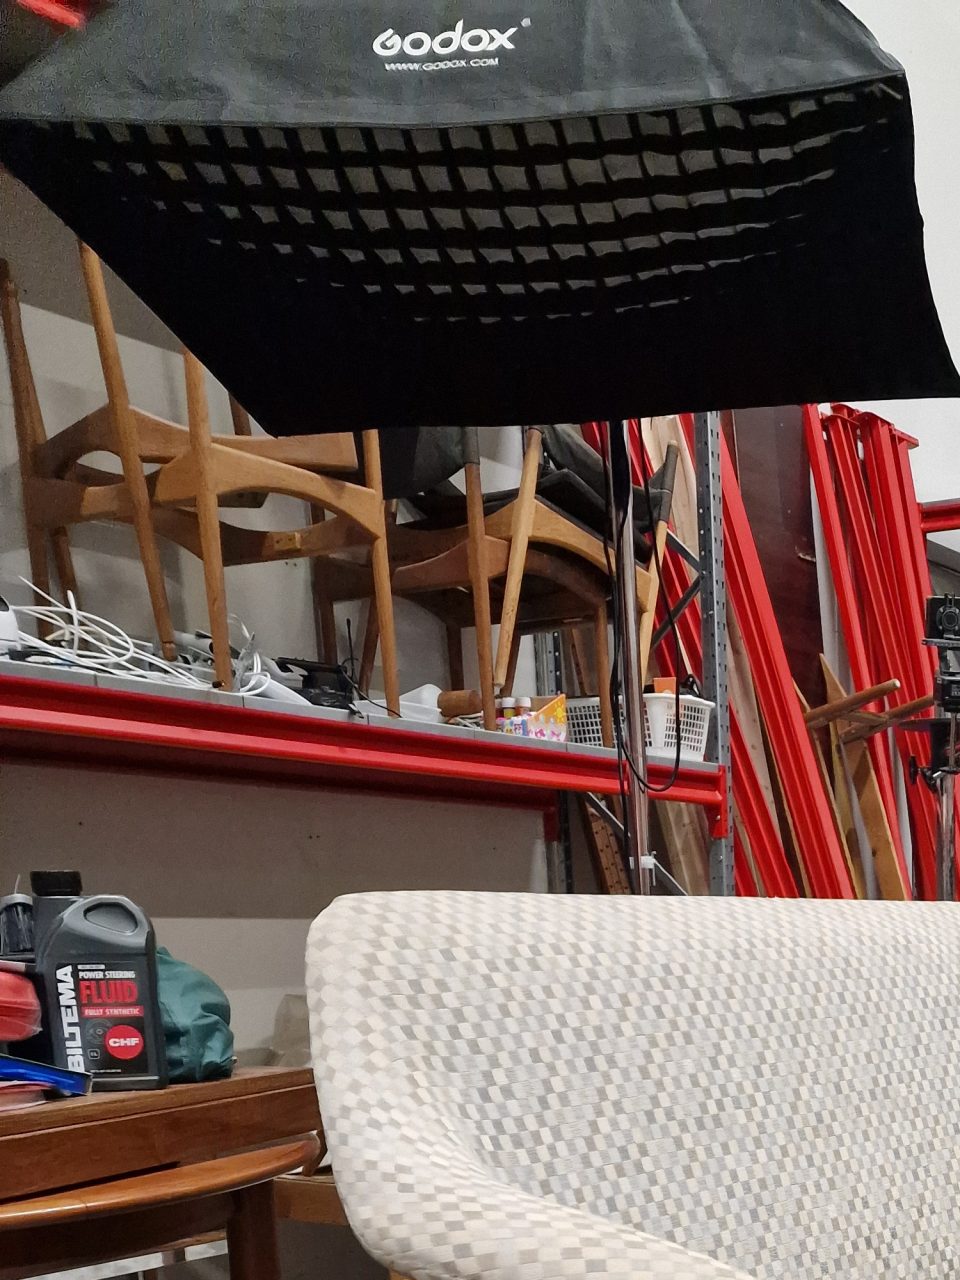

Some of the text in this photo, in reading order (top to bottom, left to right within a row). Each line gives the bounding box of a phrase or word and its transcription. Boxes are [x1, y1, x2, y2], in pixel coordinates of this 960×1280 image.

[372, 18, 518, 56] Godox
[384, 57, 499, 71] WWW.GODOX.COM
[78, 970, 135, 979] POWER STEERING
[79, 980, 138, 1004] FLUID
[56, 965, 85, 1073] BILTEMA
[105, 1008, 140, 1016] SYNTHETIC
[108, 1037, 140, 1047] CHF
